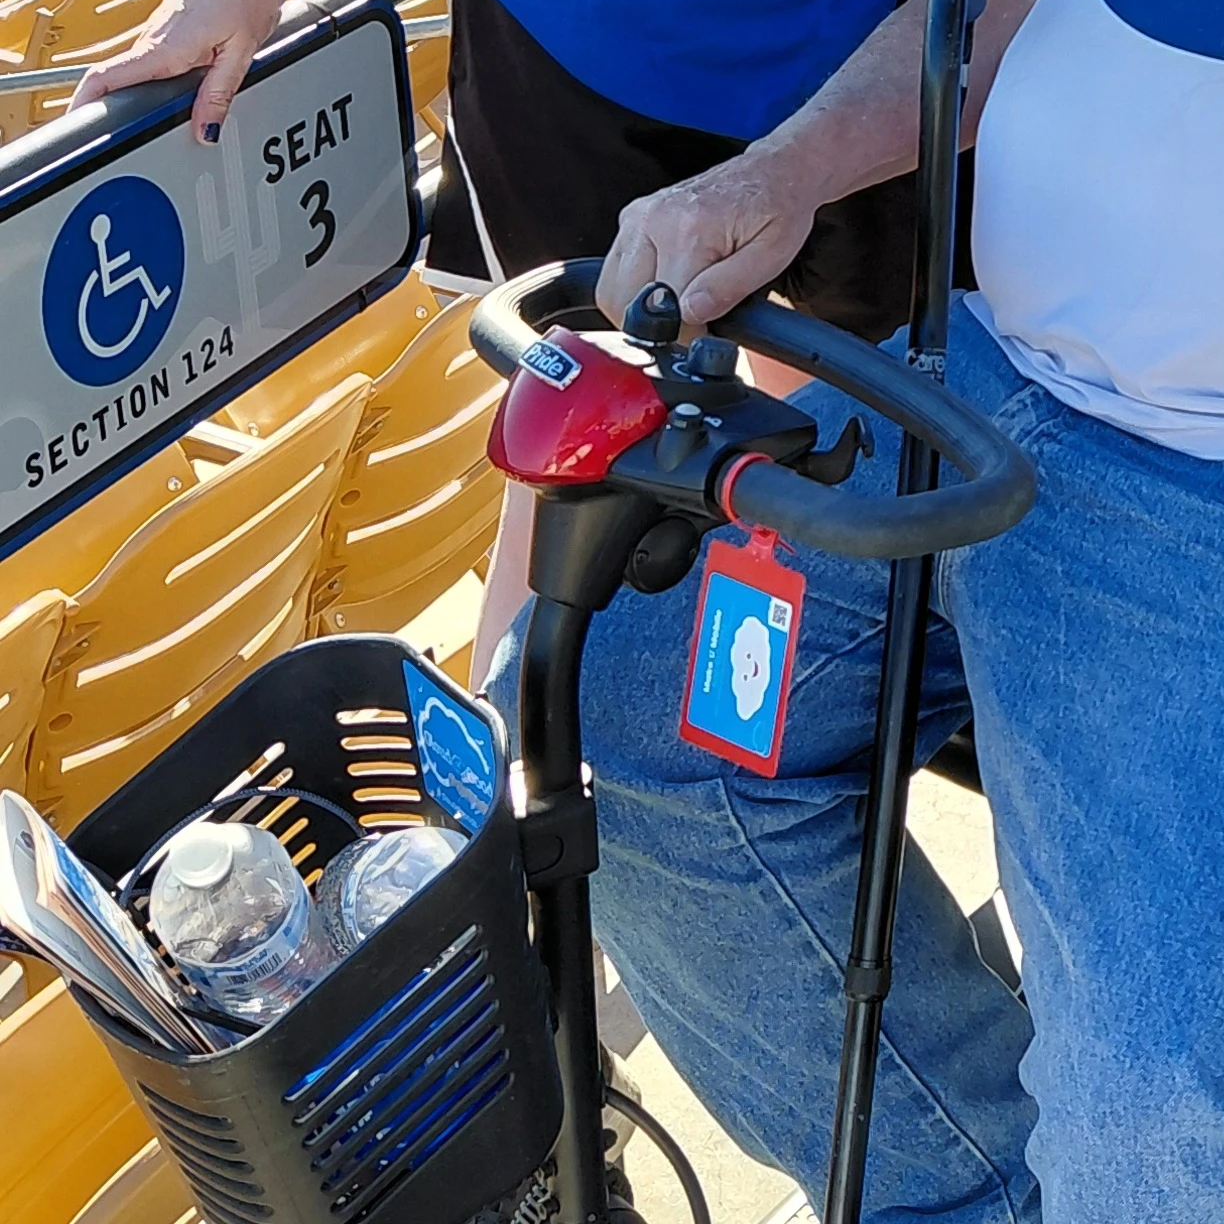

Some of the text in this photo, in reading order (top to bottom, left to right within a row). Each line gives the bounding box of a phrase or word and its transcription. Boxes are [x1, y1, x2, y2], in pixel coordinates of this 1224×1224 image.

[263, 92, 352, 184] SEAT
[299, 179, 336, 269] 3
[523, 343, 565, 377] Pride
[25, 325, 235, 489] SECTION 124
